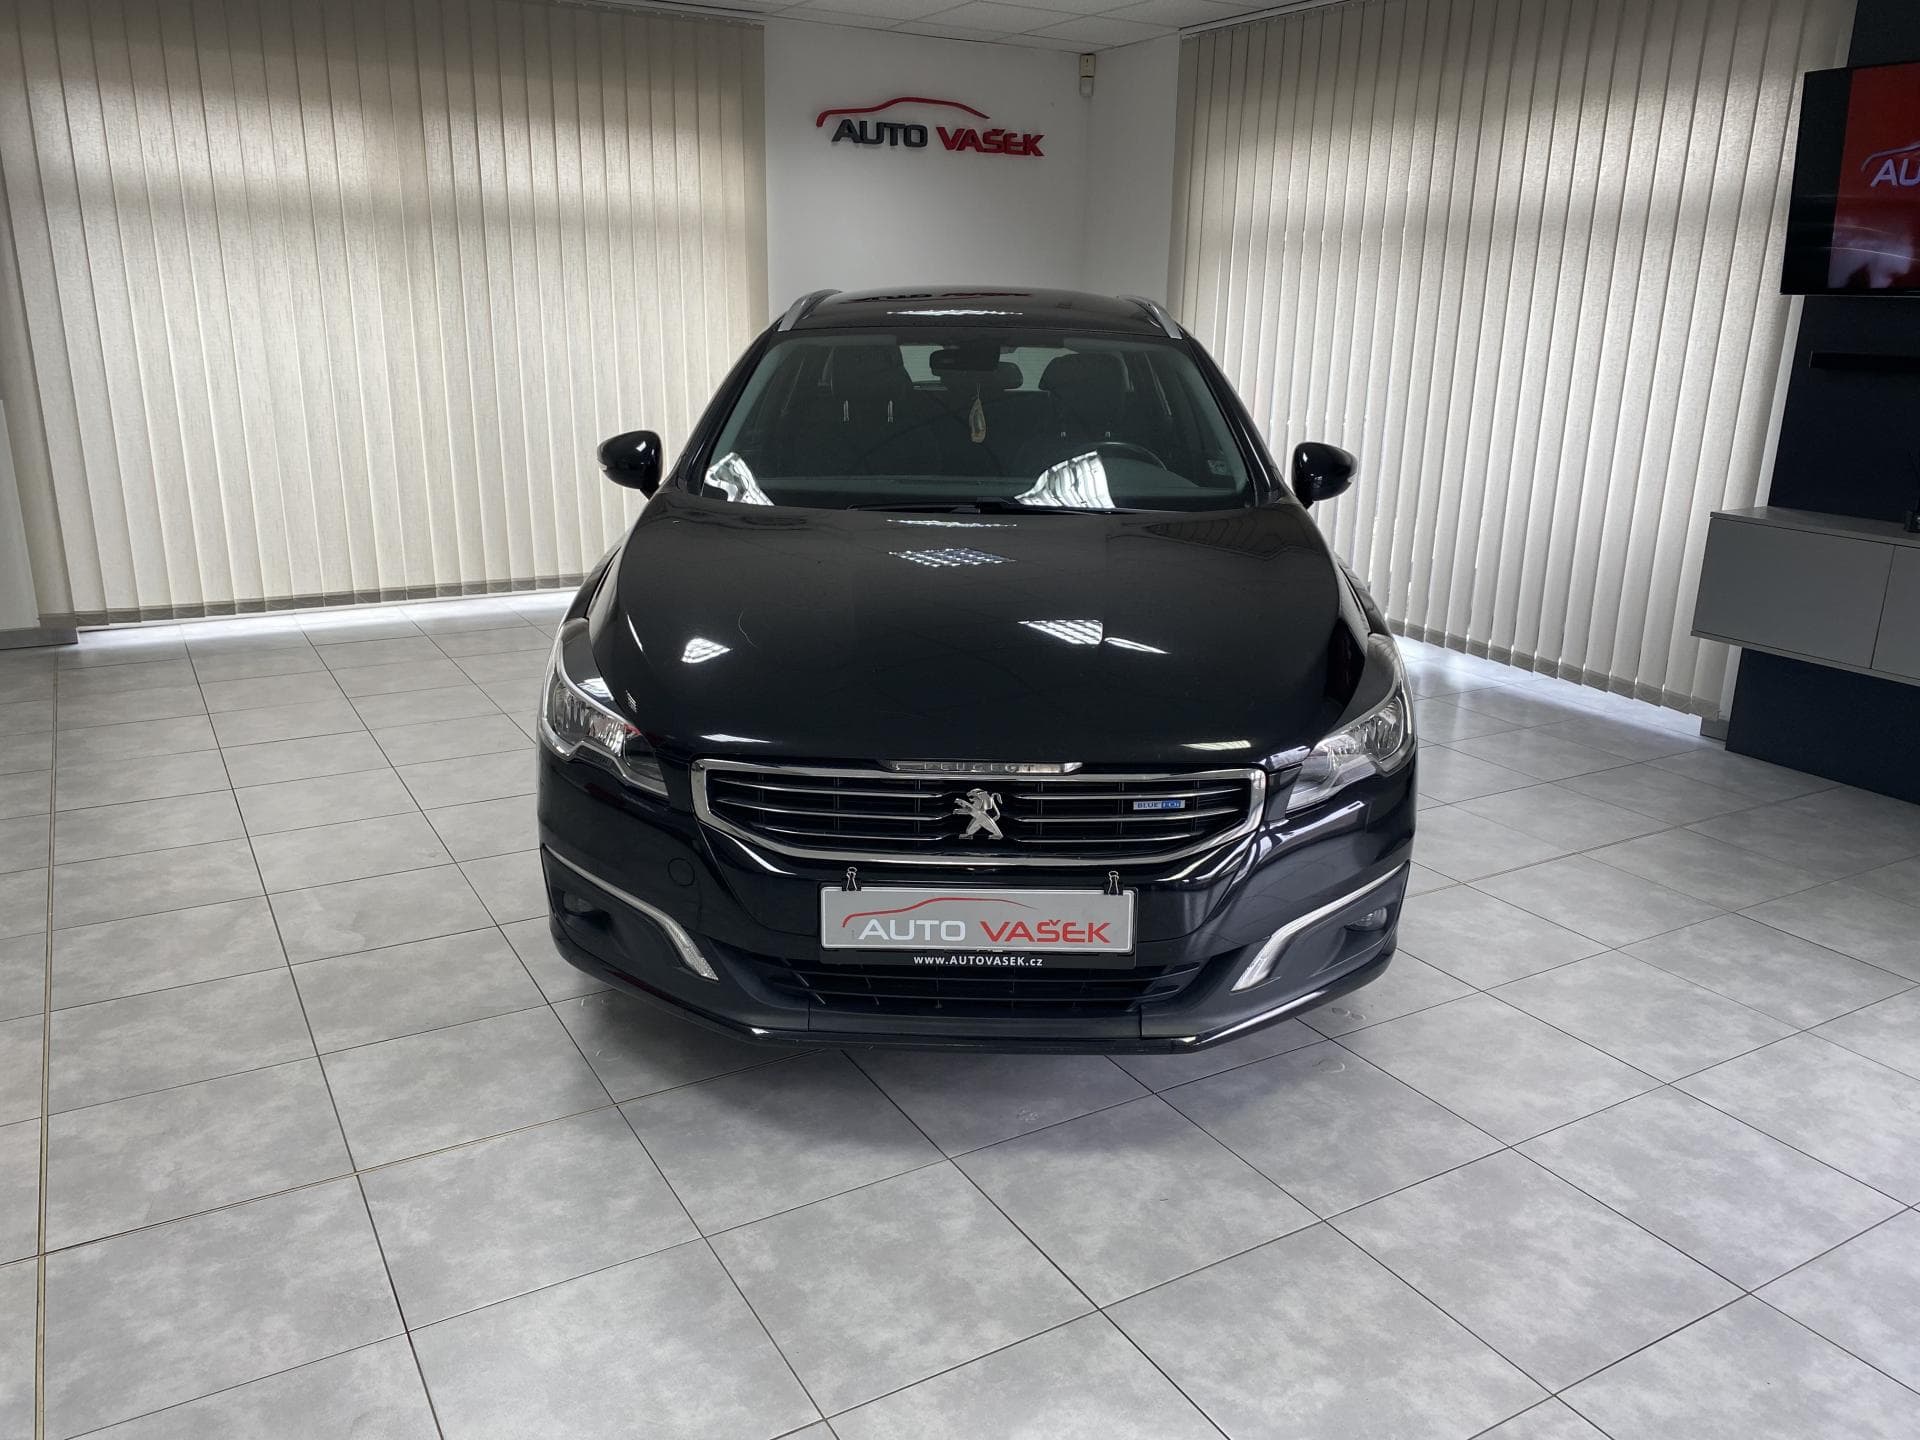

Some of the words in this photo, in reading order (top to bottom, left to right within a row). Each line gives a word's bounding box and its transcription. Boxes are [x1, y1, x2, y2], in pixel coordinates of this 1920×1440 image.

[832, 119, 929, 148] AUTO
[936, 127, 1045, 157] VAŠEK
[858, 919, 966, 942] AUTO
[979, 919, 1111, 944] VAŠEK
[913, 955, 1044, 967] www.AUTOVASEK.cz
